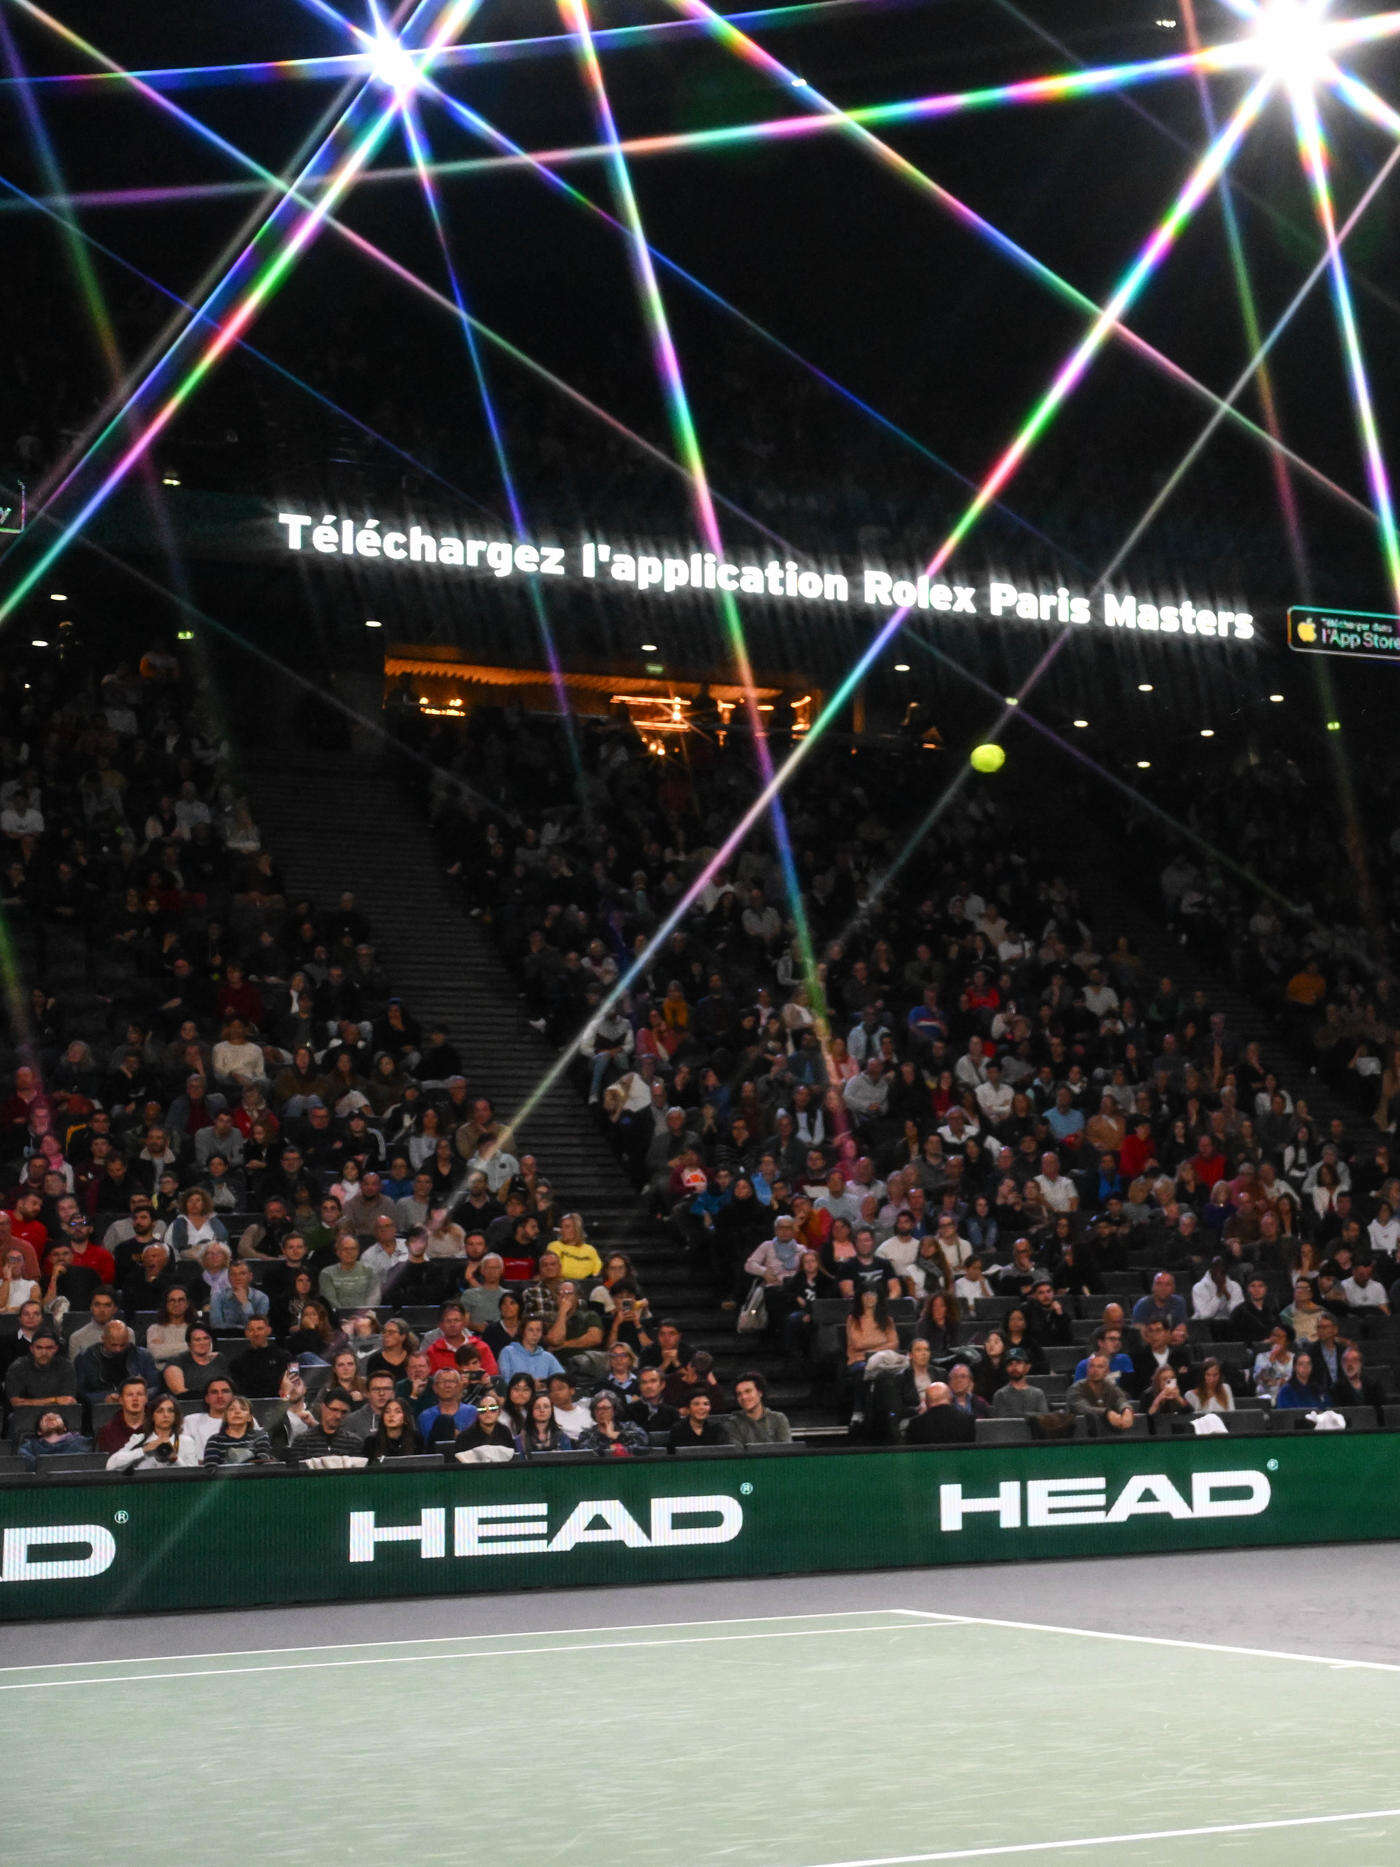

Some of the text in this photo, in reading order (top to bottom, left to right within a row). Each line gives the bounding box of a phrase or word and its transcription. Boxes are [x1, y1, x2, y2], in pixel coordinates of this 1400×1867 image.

[279, 512, 1254, 639] Téléchargez l'application Rolex Paris Masters
[349, 1494, 743, 1562] HEAD
[940, 1470, 1270, 1531] HEAD
